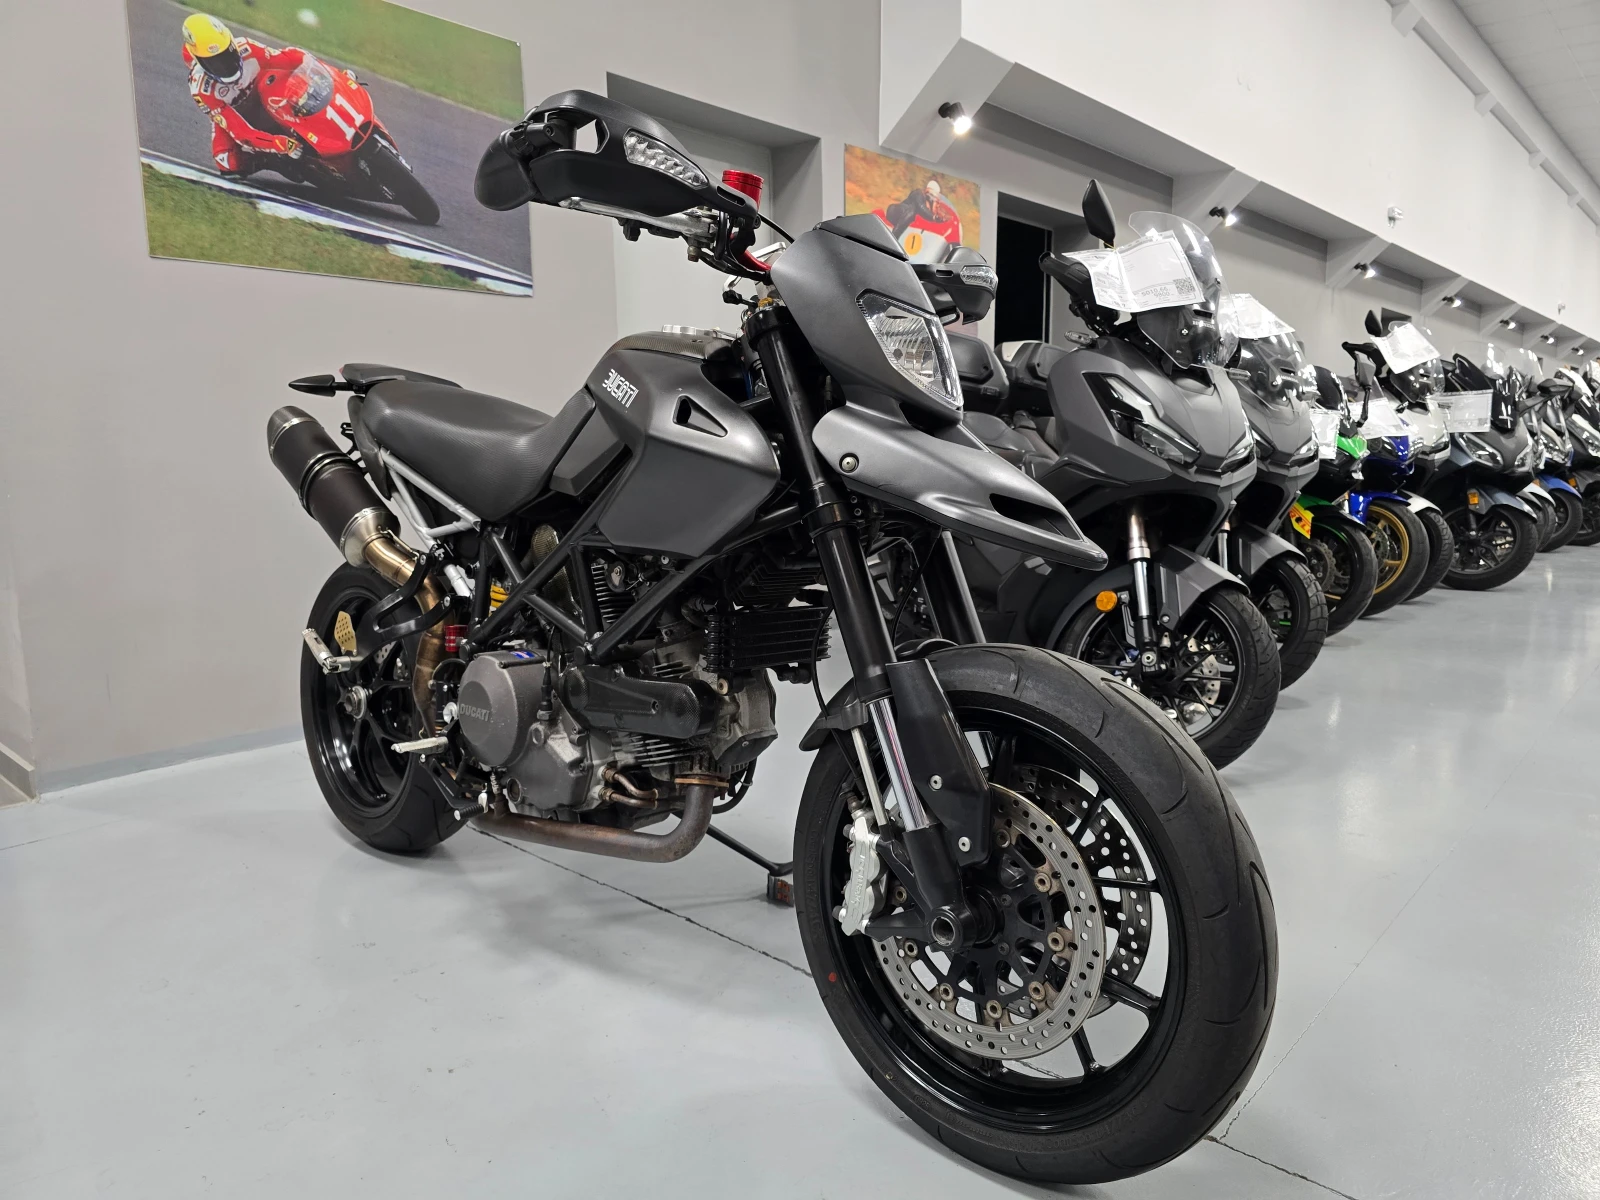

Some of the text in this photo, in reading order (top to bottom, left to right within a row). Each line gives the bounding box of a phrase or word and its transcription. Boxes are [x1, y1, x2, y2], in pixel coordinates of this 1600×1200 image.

[326, 93, 365, 142] 11
[911, 235, 916, 250] 1
[601, 368, 640, 409] DUCATI
[459, 703, 490, 722] DUCATI
